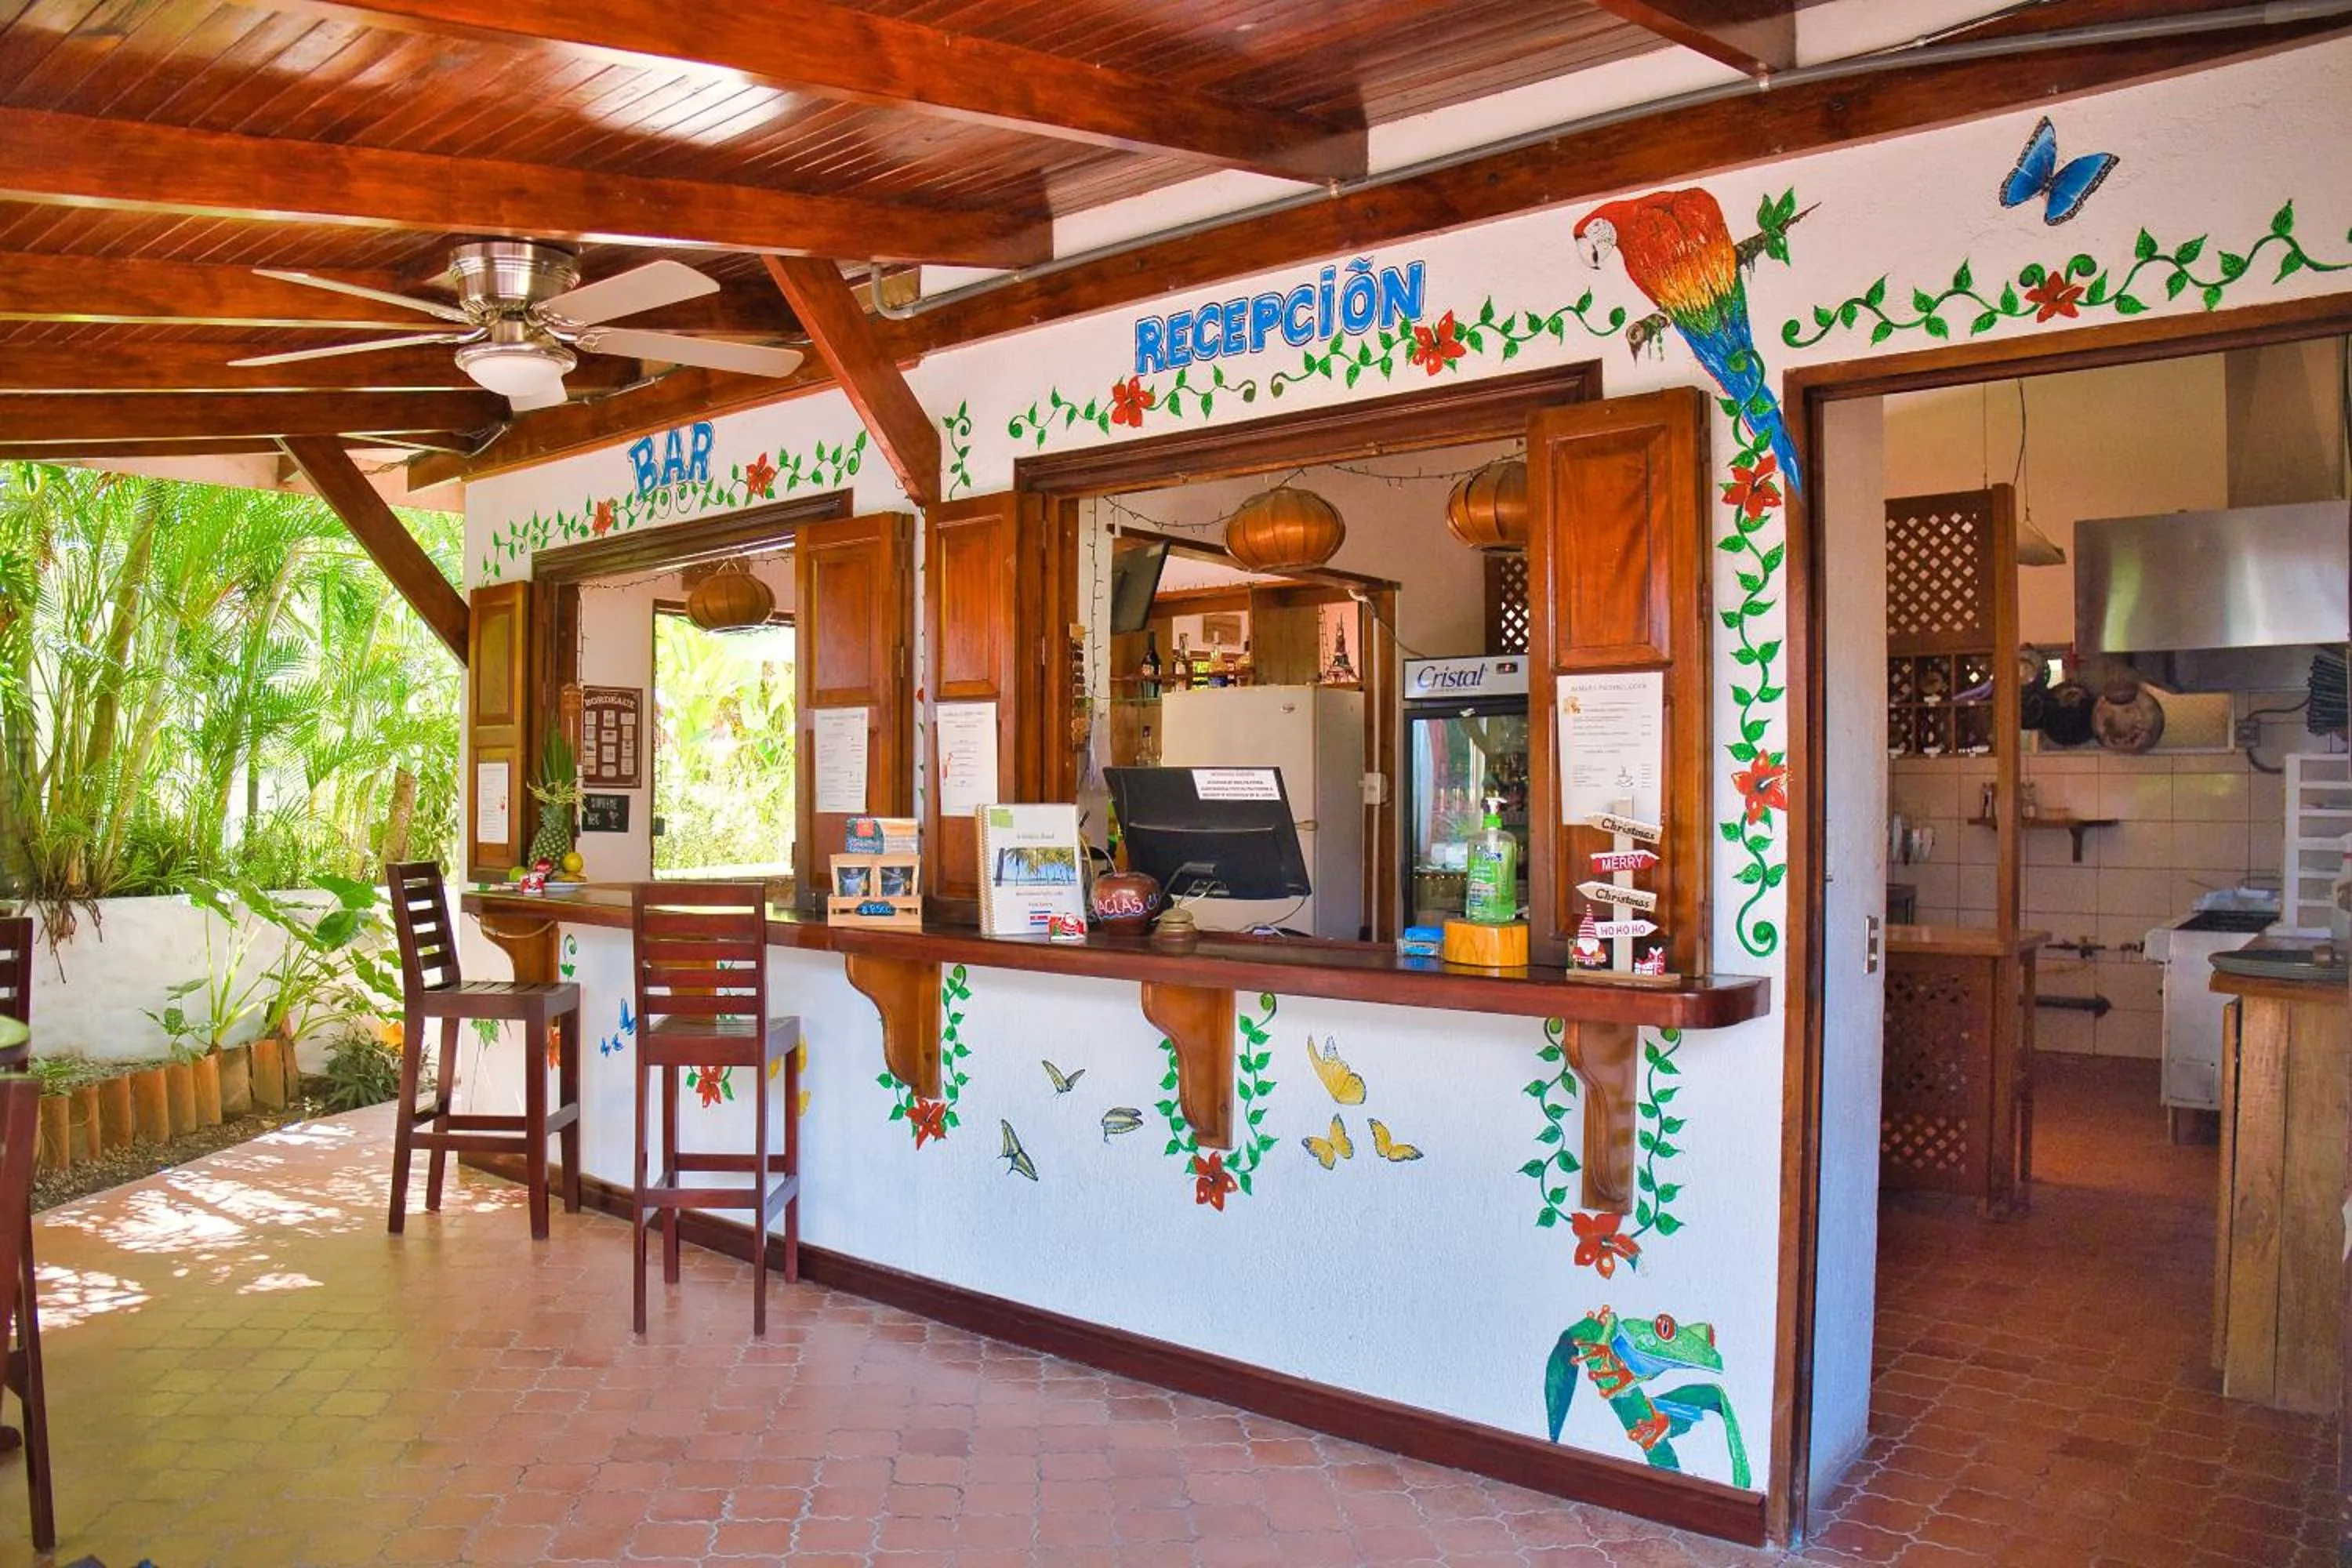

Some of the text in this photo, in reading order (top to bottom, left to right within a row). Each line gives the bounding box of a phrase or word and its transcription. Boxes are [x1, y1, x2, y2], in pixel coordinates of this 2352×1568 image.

[627, 420, 715, 500] BAR
[1417, 662, 1484, 688] Cristal
[1601, 818, 1655, 840] Christmas
[1602, 855, 1644, 871] MERRY
[1595, 888, 1650, 909] Christmas
[1601, 924, 1646, 936] HO HO HO
